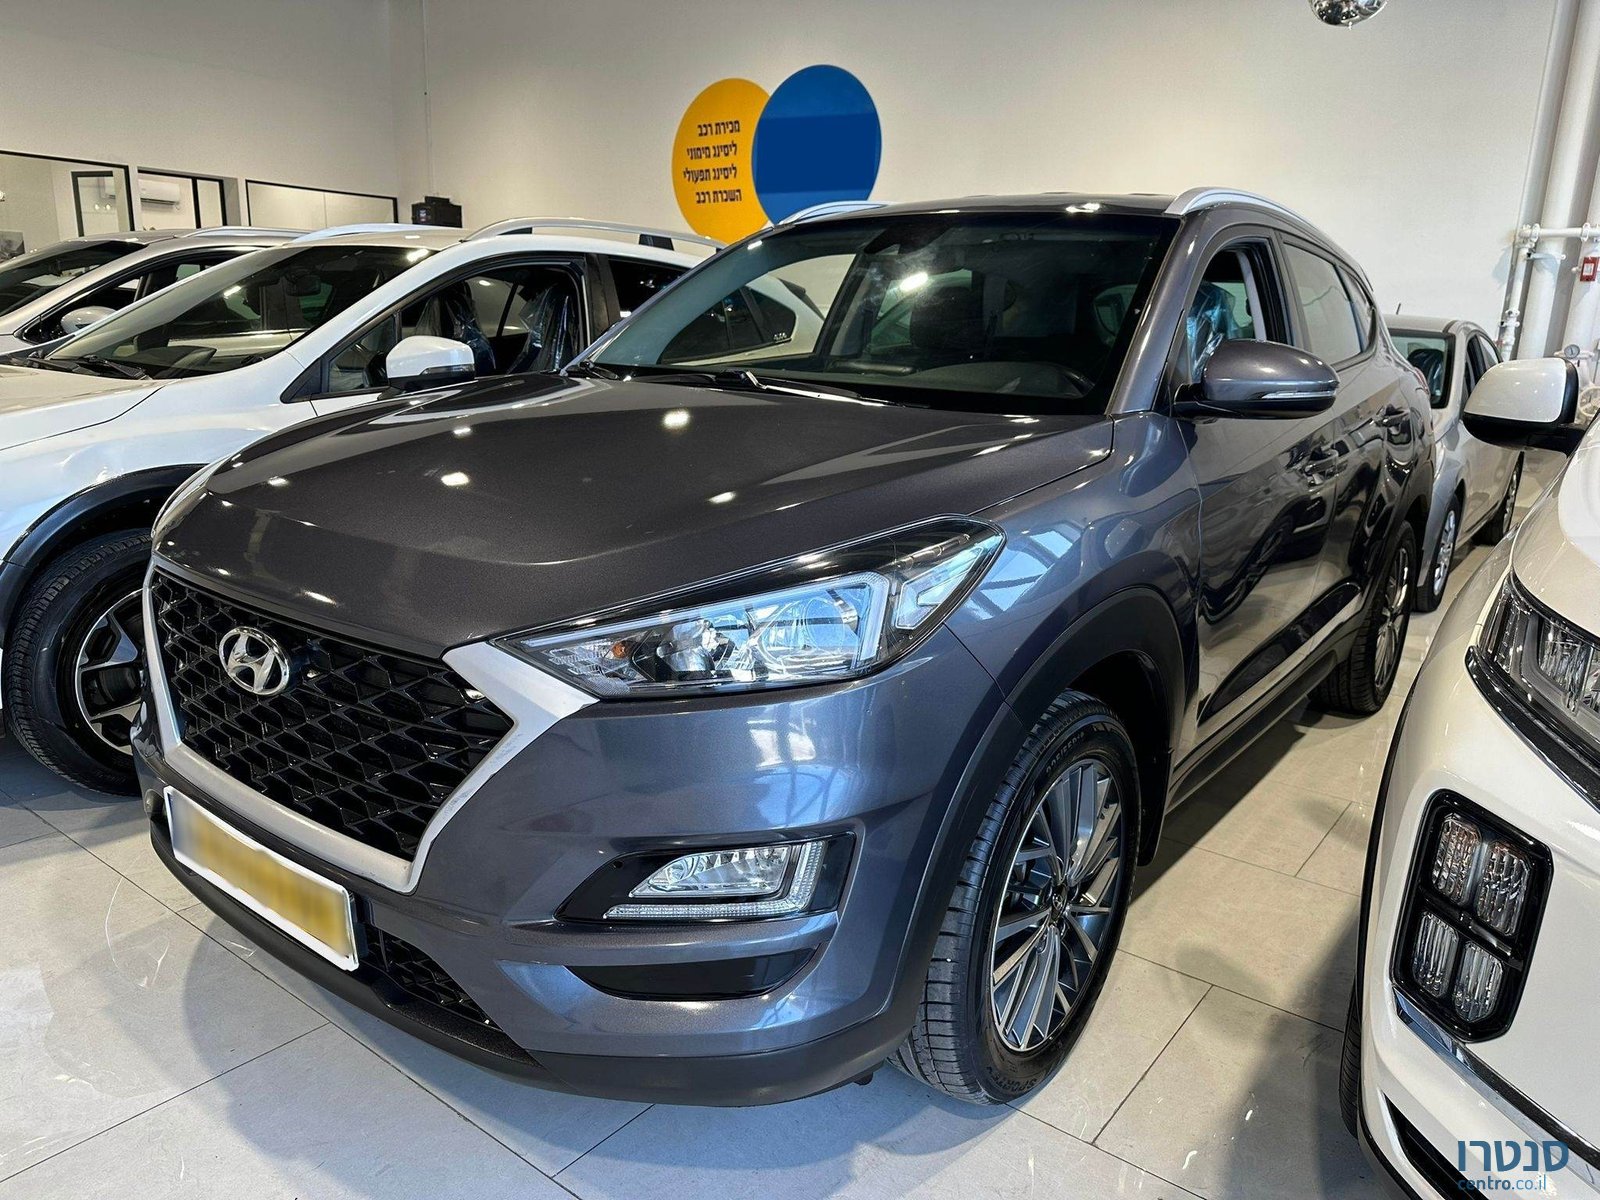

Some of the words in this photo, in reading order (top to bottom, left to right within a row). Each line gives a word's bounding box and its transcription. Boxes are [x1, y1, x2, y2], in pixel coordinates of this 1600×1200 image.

[697, 123, 713, 136] רכב
[715, 120, 740, 135] מכירת
[687, 146, 711, 160] מימוני
[712, 141, 737, 157] ליסינג
[683, 167, 711, 184] תפעולי
[712, 164, 737, 180] ליסינג
[696, 191, 711, 204] רכב
[712, 189, 742, 202] השכרת
